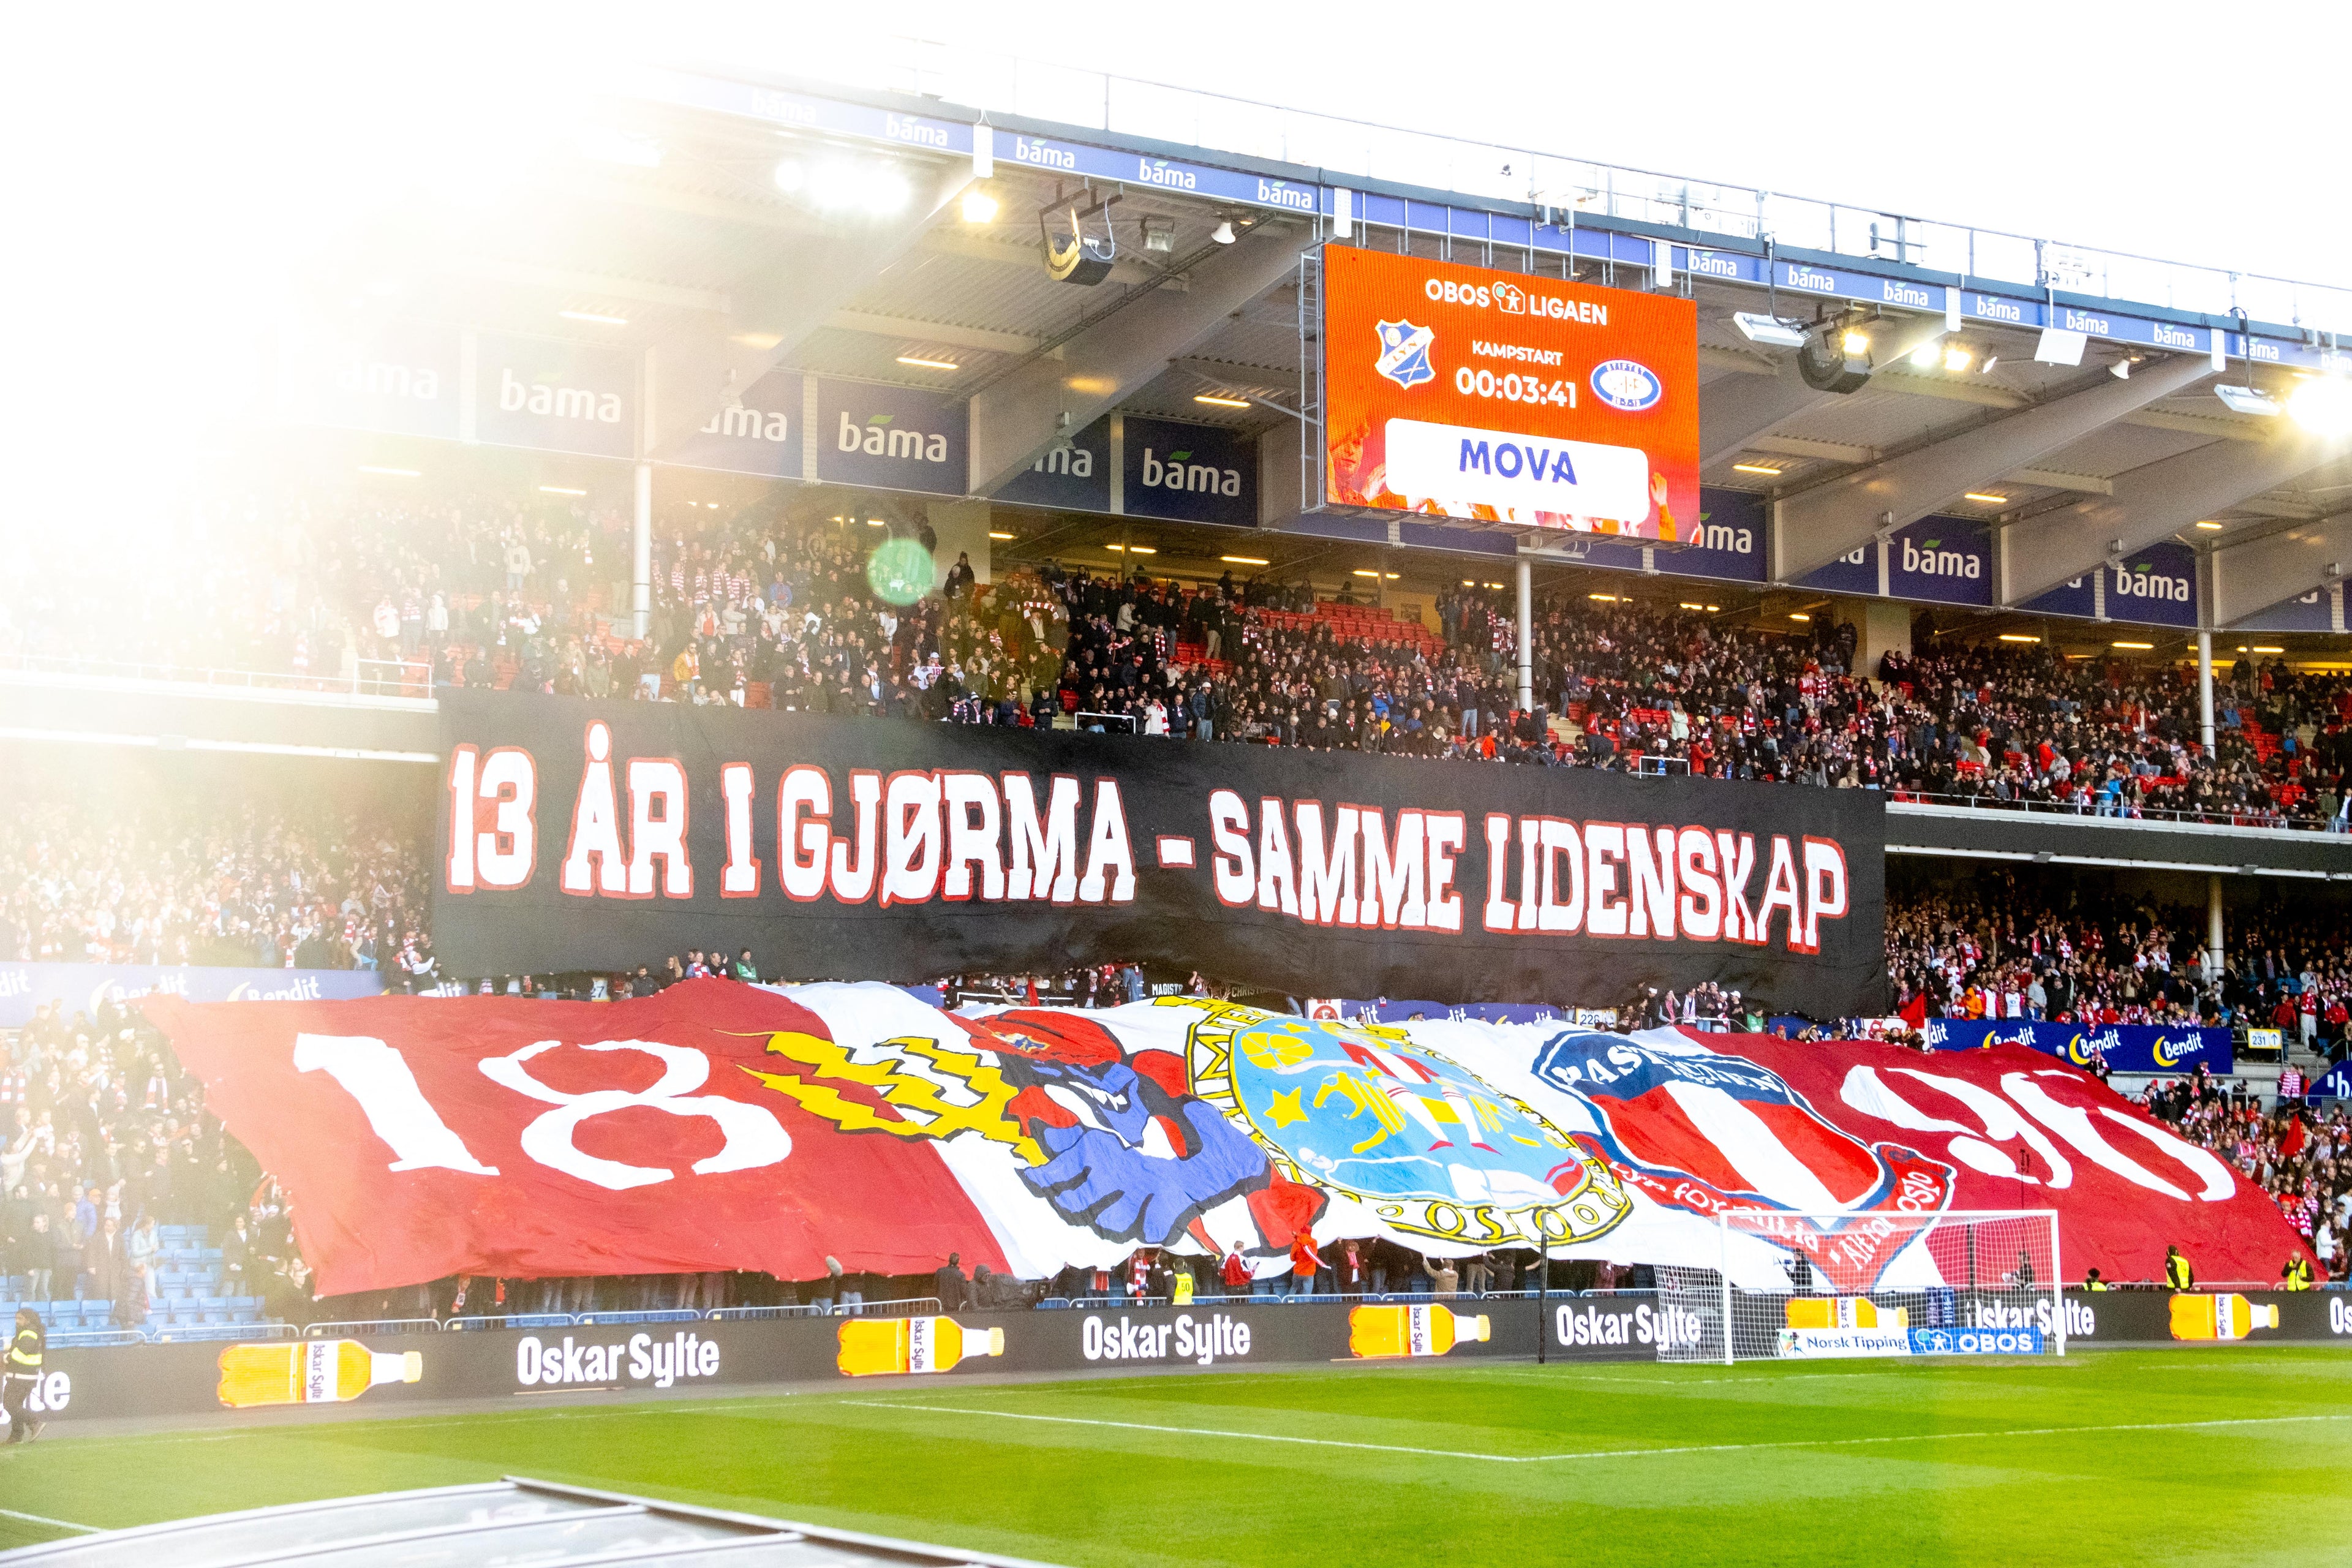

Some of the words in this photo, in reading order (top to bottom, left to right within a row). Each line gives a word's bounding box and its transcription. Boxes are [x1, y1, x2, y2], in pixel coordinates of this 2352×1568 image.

[1425, 279, 1490, 307] OBOS
[1530, 295, 1607, 325] LIGAEN
[1472, 340, 1562, 366] KAMPSTART
[1456, 367, 1577, 409] 00:03:41
[1459, 439, 1578, 485] MOVA
[447, 742, 538, 894] 13
[560, 719, 694, 899] ÅR
[720, 761, 761, 898] I
[778, 764, 1139, 908] GJØRMA
[1208, 789, 1466, 934] SAMME
[1483, 812, 1850, 954] LIDENSKAP
[2080, 1029, 2121, 1057] Bendit
[2163, 1032, 2204, 1059] Bendit
[2252, 1035, 2266, 1046] 231
[293, 1032, 793, 1190] 18
[1082, 1316, 1170, 1360] Oskar
[1175, 1314, 1251, 1365] Sylte
[1556, 1305, 1634, 1346] Oskar
[1635, 1304, 1702, 1351] Sylte
[1807, 1336, 1850, 1348] Norsk
[1852, 1335, 1907, 1352] Tipping
[1959, 1333, 2033, 1352] OBOS
[517, 1336, 625, 1385] Oskar
[628, 1332, 719, 1388] Sylte
